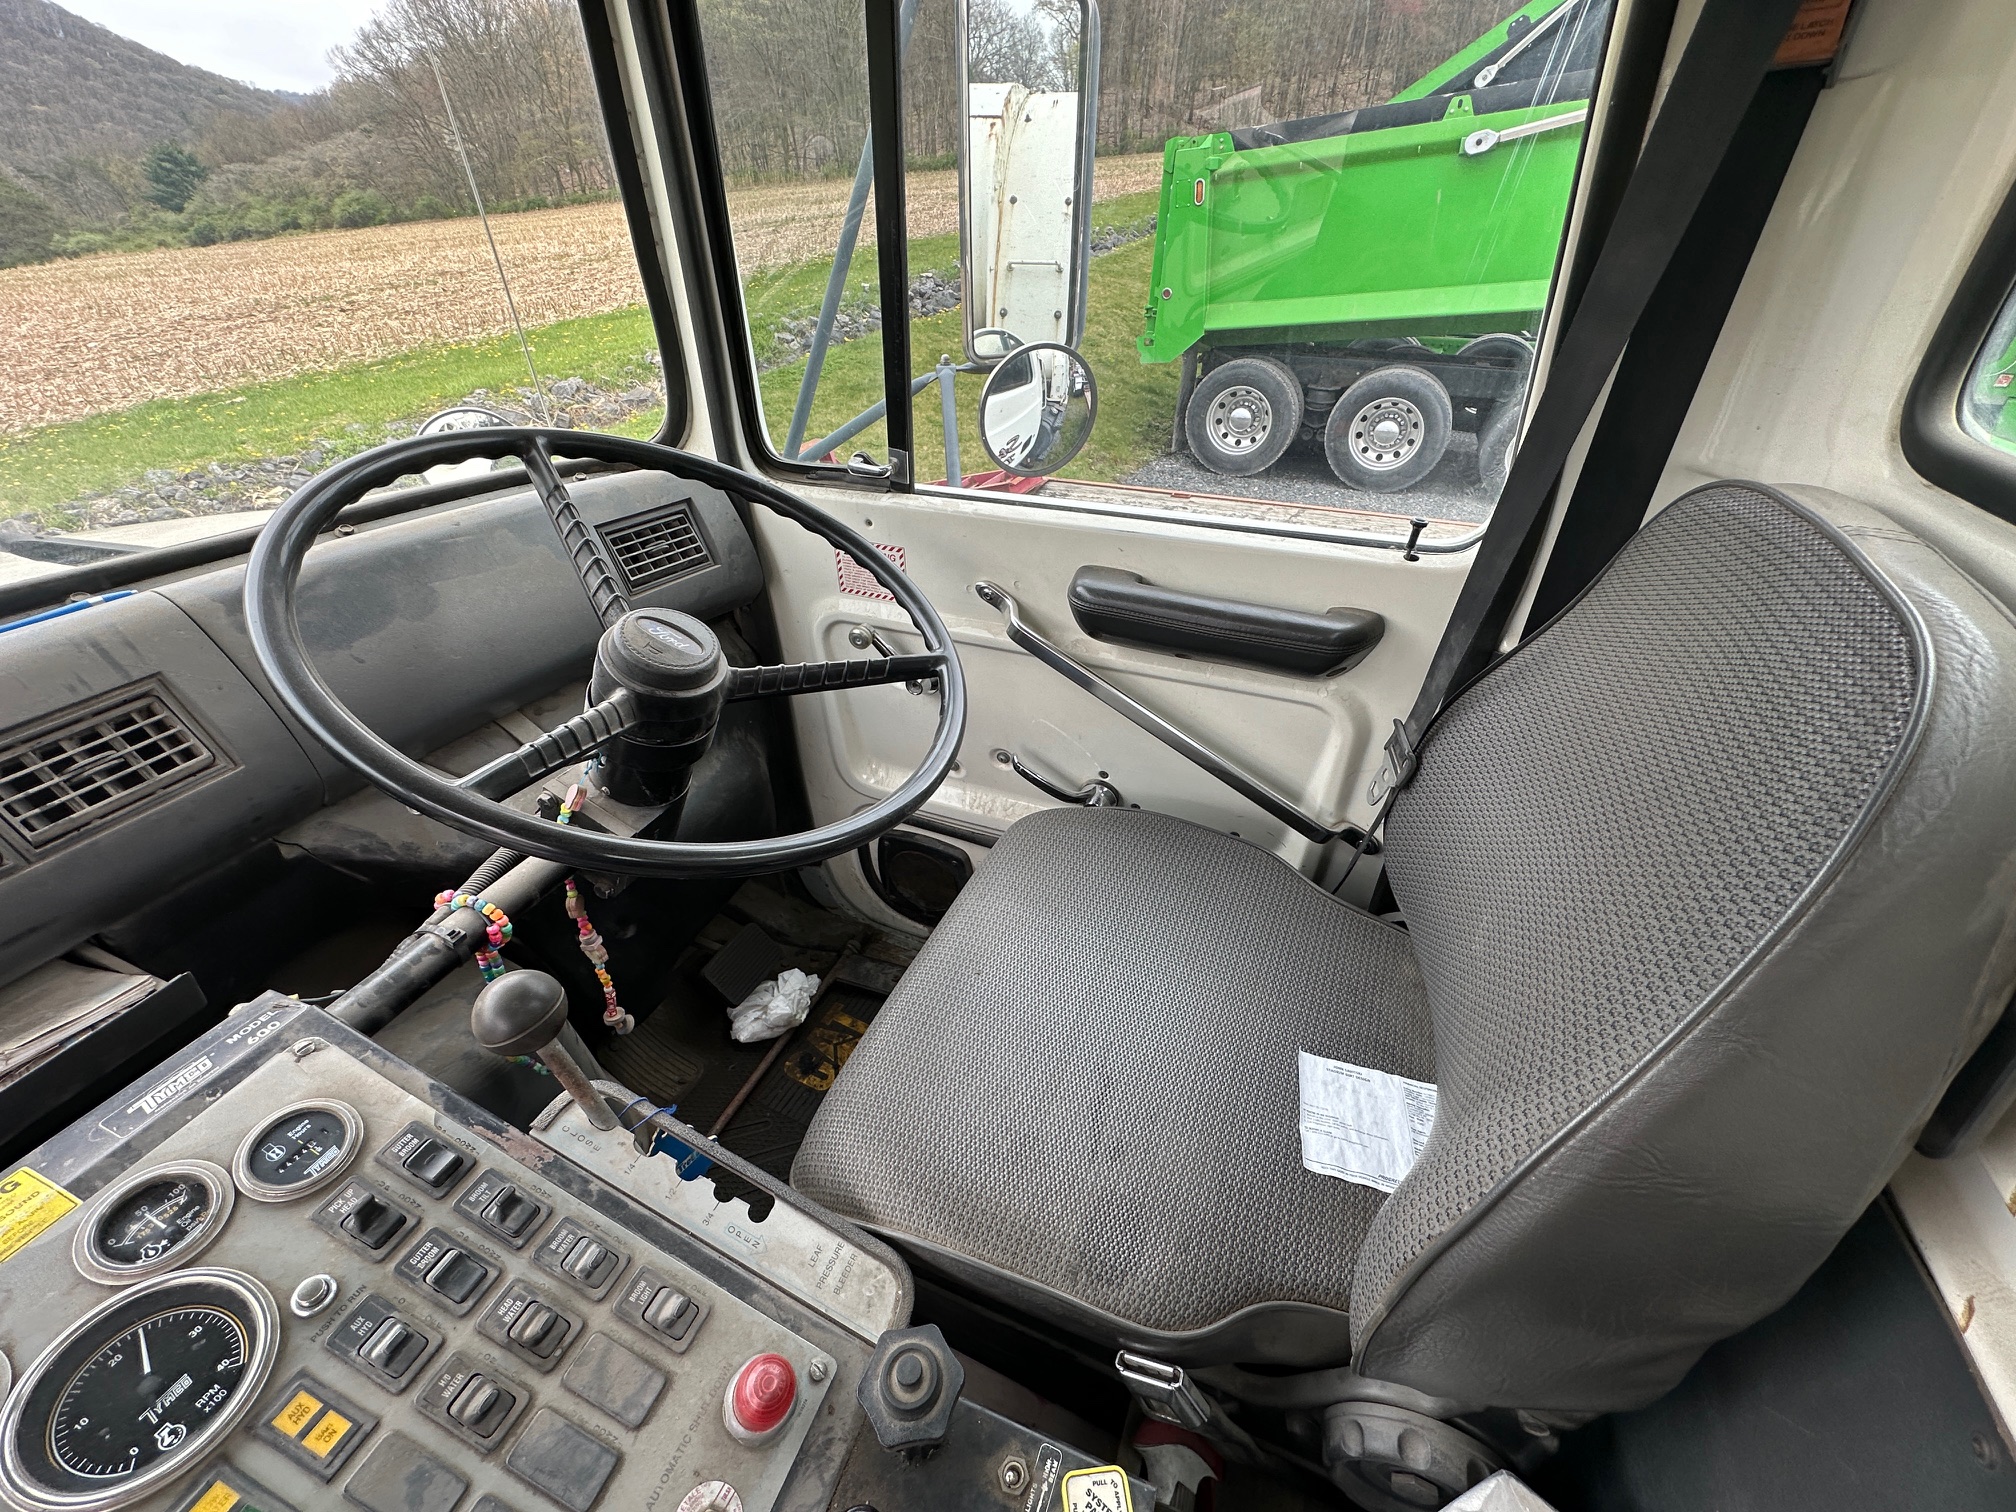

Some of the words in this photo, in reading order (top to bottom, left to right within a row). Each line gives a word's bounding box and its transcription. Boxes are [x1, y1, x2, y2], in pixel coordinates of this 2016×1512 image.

[648, 626, 690, 648] Ford
[225, 1009, 280, 1044] MODEL
[247, 1021, 281, 1045] 600
[126, 1055, 214, 1115] TYMCO
[287, 1119, 310, 1137] Engine
[291, 1124, 312, 1140] Hours
[391, 1133, 413, 1153] GUTTER
[398, 1137, 420, 1157] BROOM
[561, 1125, 601, 1152] CLOSE
[624, 1163, 636, 1176] 1/4
[168, 1183, 186, 1198] 100
[468, 1181, 488, 1202] BROOM
[479, 1190, 491, 1203] TILT
[664, 1186, 677, 1200] 1/2
[134, 1205, 149, 1217] 50
[328, 1198, 343, 1214] PICK
[344, 1188, 354, 1198] UP
[340, 1197, 358, 1214] HEAD
[176, 1205, 200, 1225] Engine
[702, 1212, 714, 1226] 3/4
[107, 1238, 117, 1246] 0
[550, 1229, 569, 1251] BROOM
[557, 1234, 575, 1254] WATER
[727, 1225, 761, 1249] OPEN
[410, 1241, 433, 1265] GUTTER
[418, 1246, 440, 1269] BROOM
[807, 1243, 823, 1268] LEAF
[815, 1240, 846, 1290] PRESSURE
[833, 1253, 858, 1296] BLEEDER
[628, 1280, 647, 1303] BROOM
[638, 1286, 653, 1305] LIGHT
[310, 1316, 337, 1343] PUSH
[334, 1304, 348, 1318] TO
[349, 1284, 368, 1304] RUN
[497, 1298, 514, 1315] HEAD
[502, 1300, 523, 1323] WATER
[188, 1325, 203, 1338] 30
[350, 1316, 366, 1332] AUX
[358, 1321, 373, 1336] HYD
[108, 1353, 123, 1367] 20
[216, 1358, 231, 1372] 40
[194, 1383, 221, 1408] RPM
[441, 1372, 465, 1399] WATER
[138, 1373, 193, 1425] TYMCO
[203, 1389, 228, 1414] x100
[287, 1401, 305, 1420] AUX
[292, 1405, 311, 1426] HYD
[74, 1417, 90, 1431] 10
[323, 1429, 338, 1444] ON
[129, 1446, 140, 1456] 0
[645, 1434, 692, 1511] AUTOMATIC
[1048, 1459, 1059, 1484] BEAM
[1092, 1479, 1108, 1487] PULL
[1110, 1478, 1119, 1489] TO
[1114, 1490, 1122, 1512] APPL
